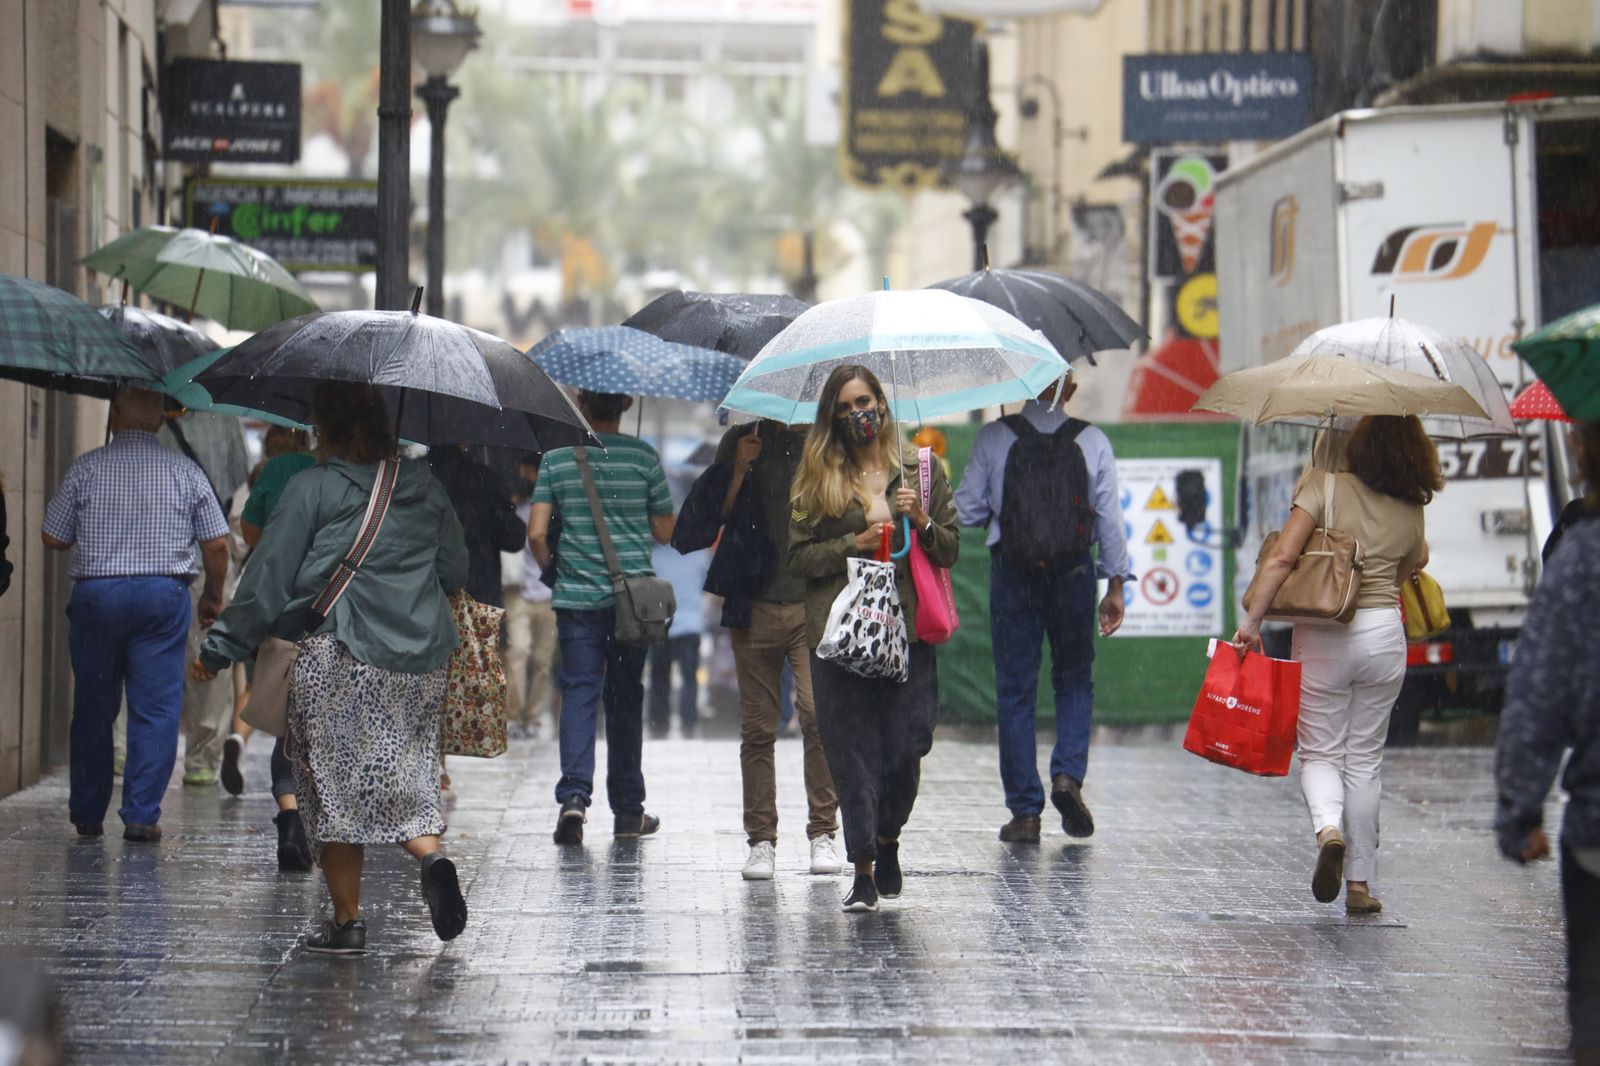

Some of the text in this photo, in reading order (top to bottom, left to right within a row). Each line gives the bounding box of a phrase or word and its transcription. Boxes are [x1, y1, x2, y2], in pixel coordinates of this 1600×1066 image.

[1139, 69, 1207, 101] Ulloa
[1206, 692, 1227, 704] ALVARO
[1236, 703, 1261, 715] MORENO
